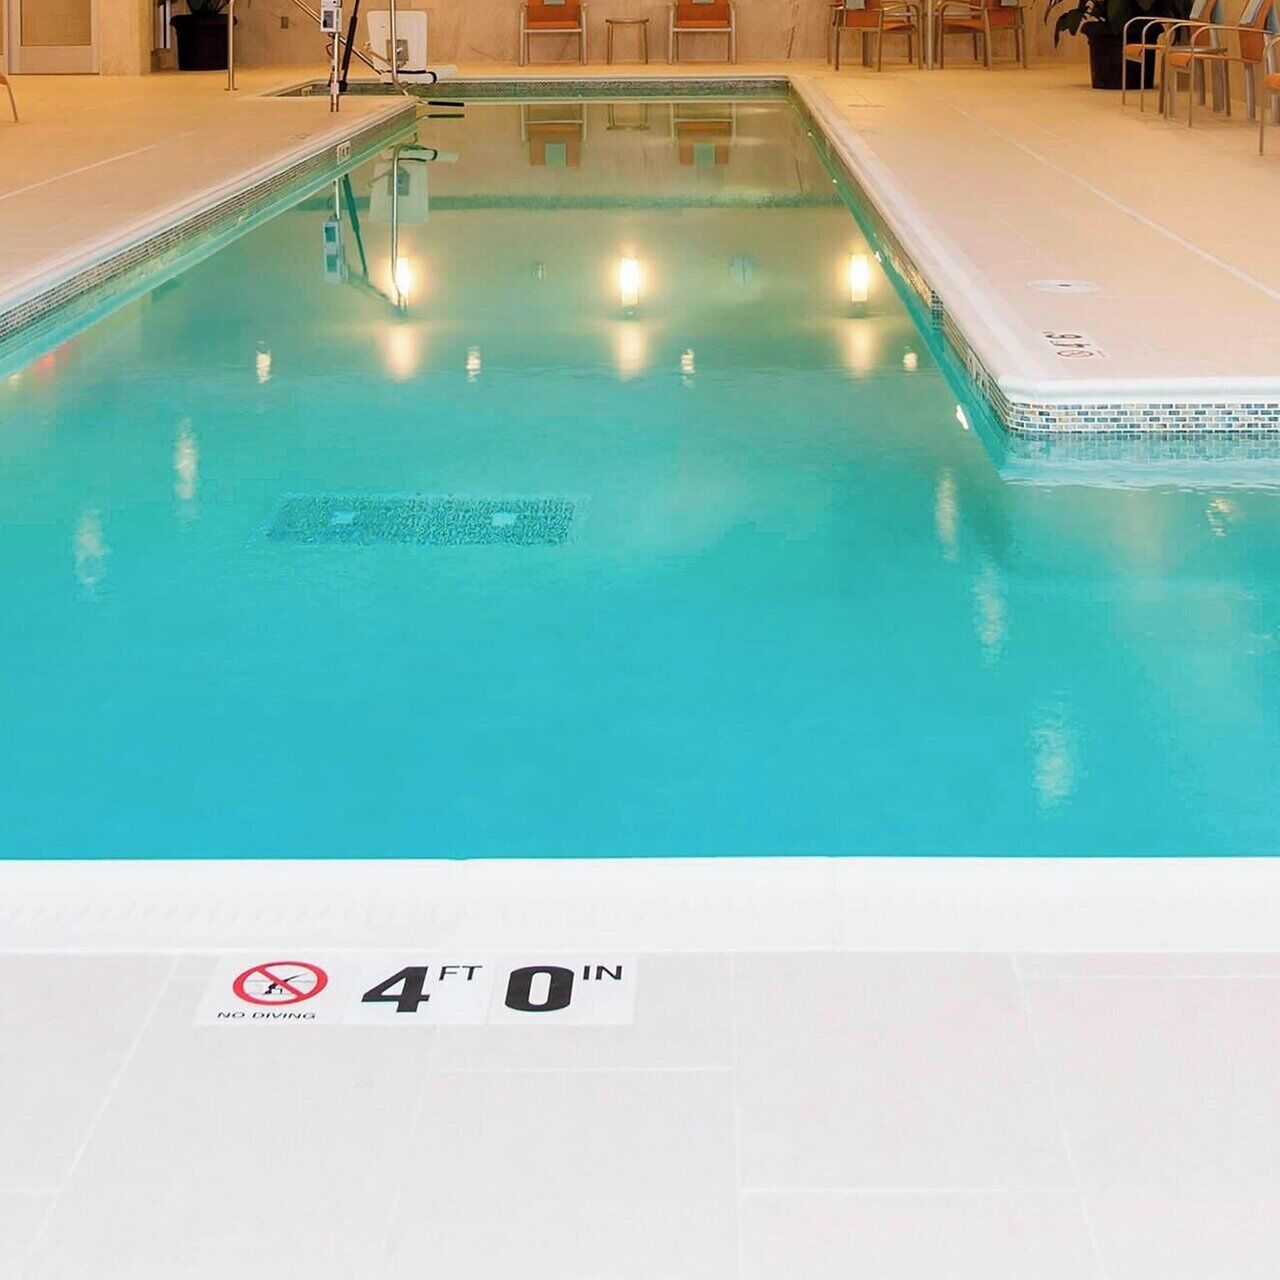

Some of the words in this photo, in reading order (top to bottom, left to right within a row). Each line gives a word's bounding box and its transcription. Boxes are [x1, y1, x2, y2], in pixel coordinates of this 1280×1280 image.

[360, 965, 431, 1013] 4
[438, 965, 483, 981] FT
[503, 965, 575, 1013] 0
[582, 965, 624, 981] IN
[216, 1010, 247, 1019] NO
[250, 1010, 318, 1020] DIVING
